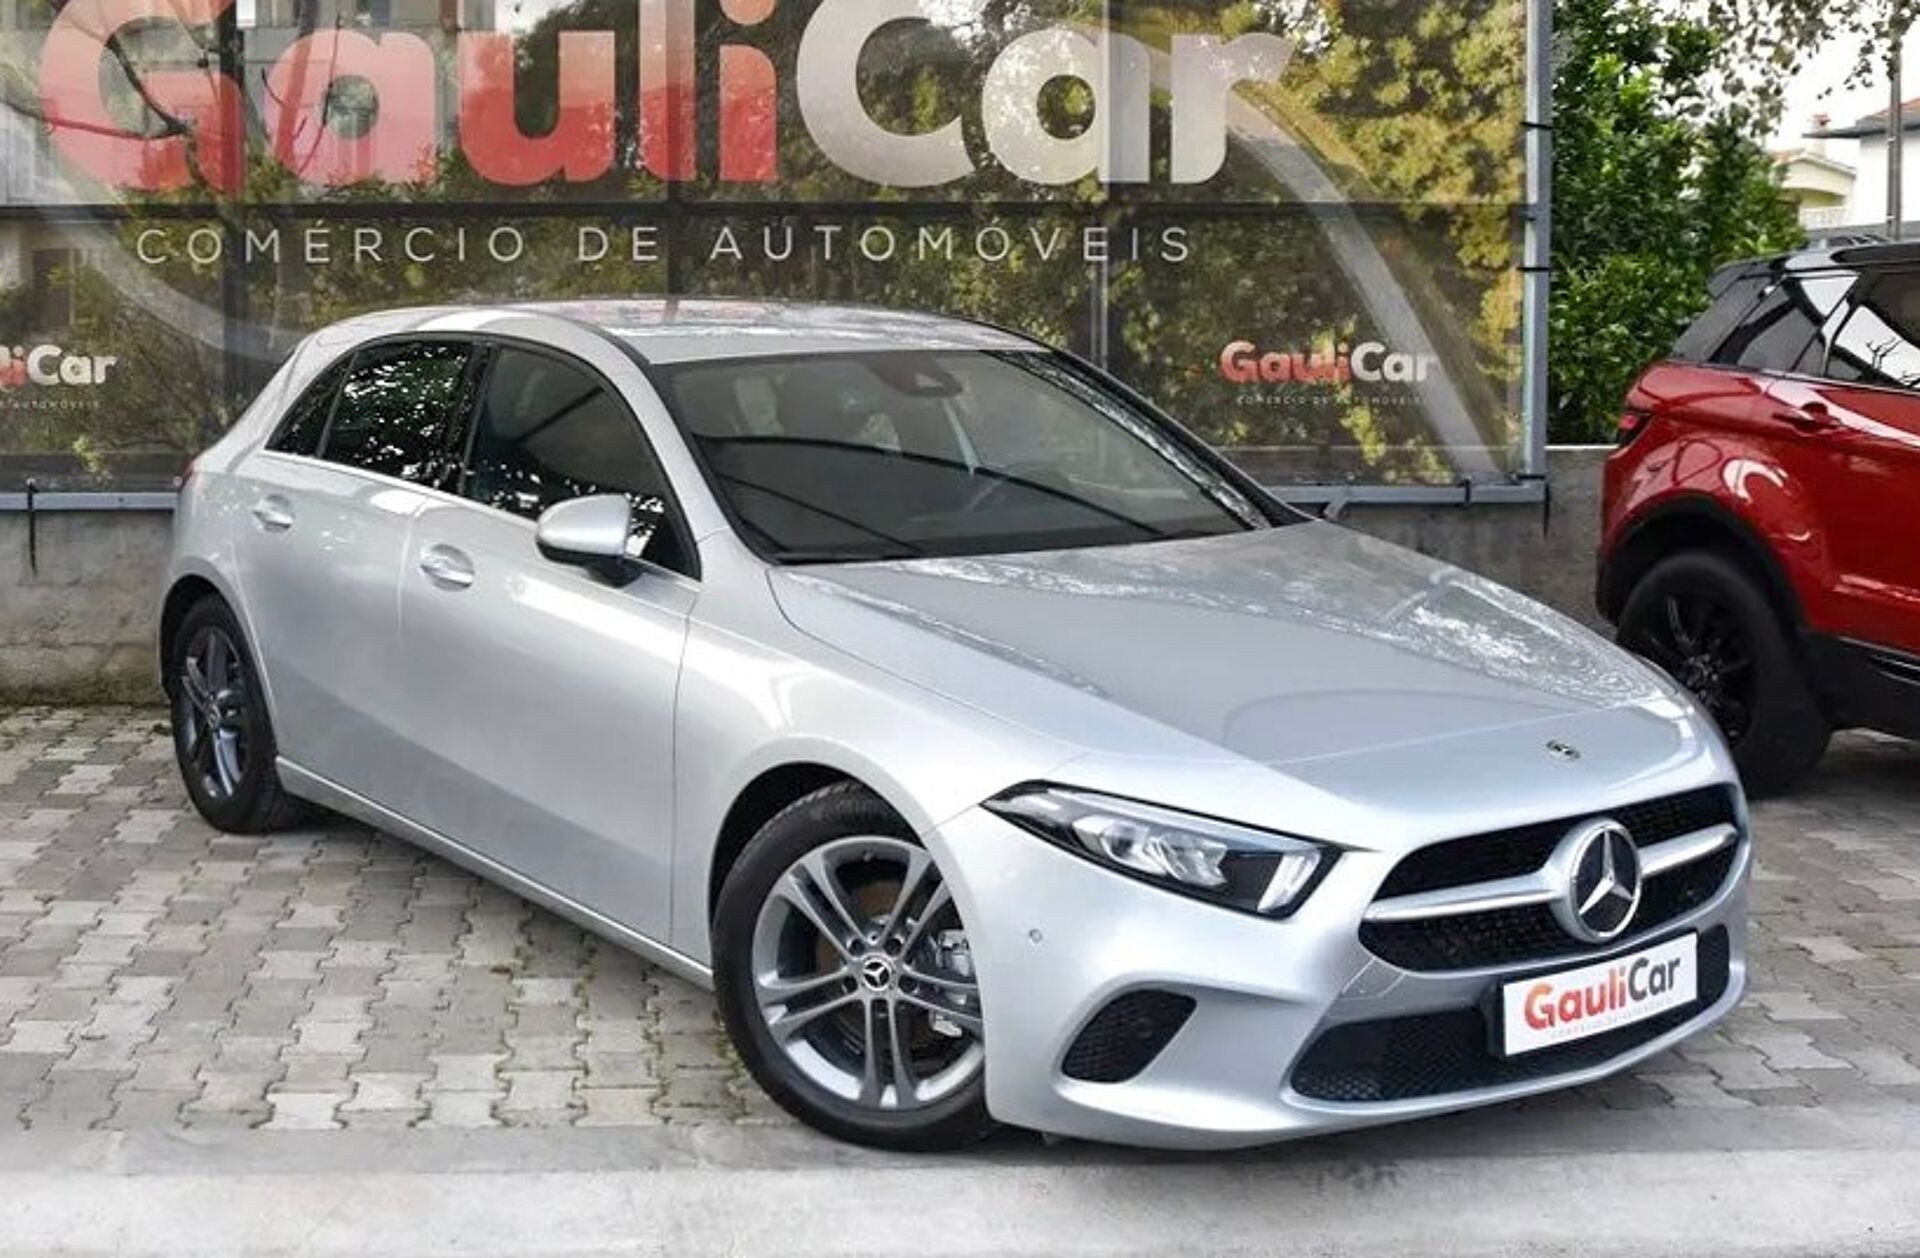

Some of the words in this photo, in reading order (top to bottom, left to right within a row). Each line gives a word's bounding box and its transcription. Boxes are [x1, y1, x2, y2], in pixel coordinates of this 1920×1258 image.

[40, 0, 1294, 189] GauliCar
[136, 219, 524, 264] COMÉRCIO
[577, 226, 658, 262] DE
[709, 218, 1190, 262] AUTOMÓVEIS
[1219, 339, 1438, 384] GauliCar
[1523, 956, 1681, 1030] GauliCar
